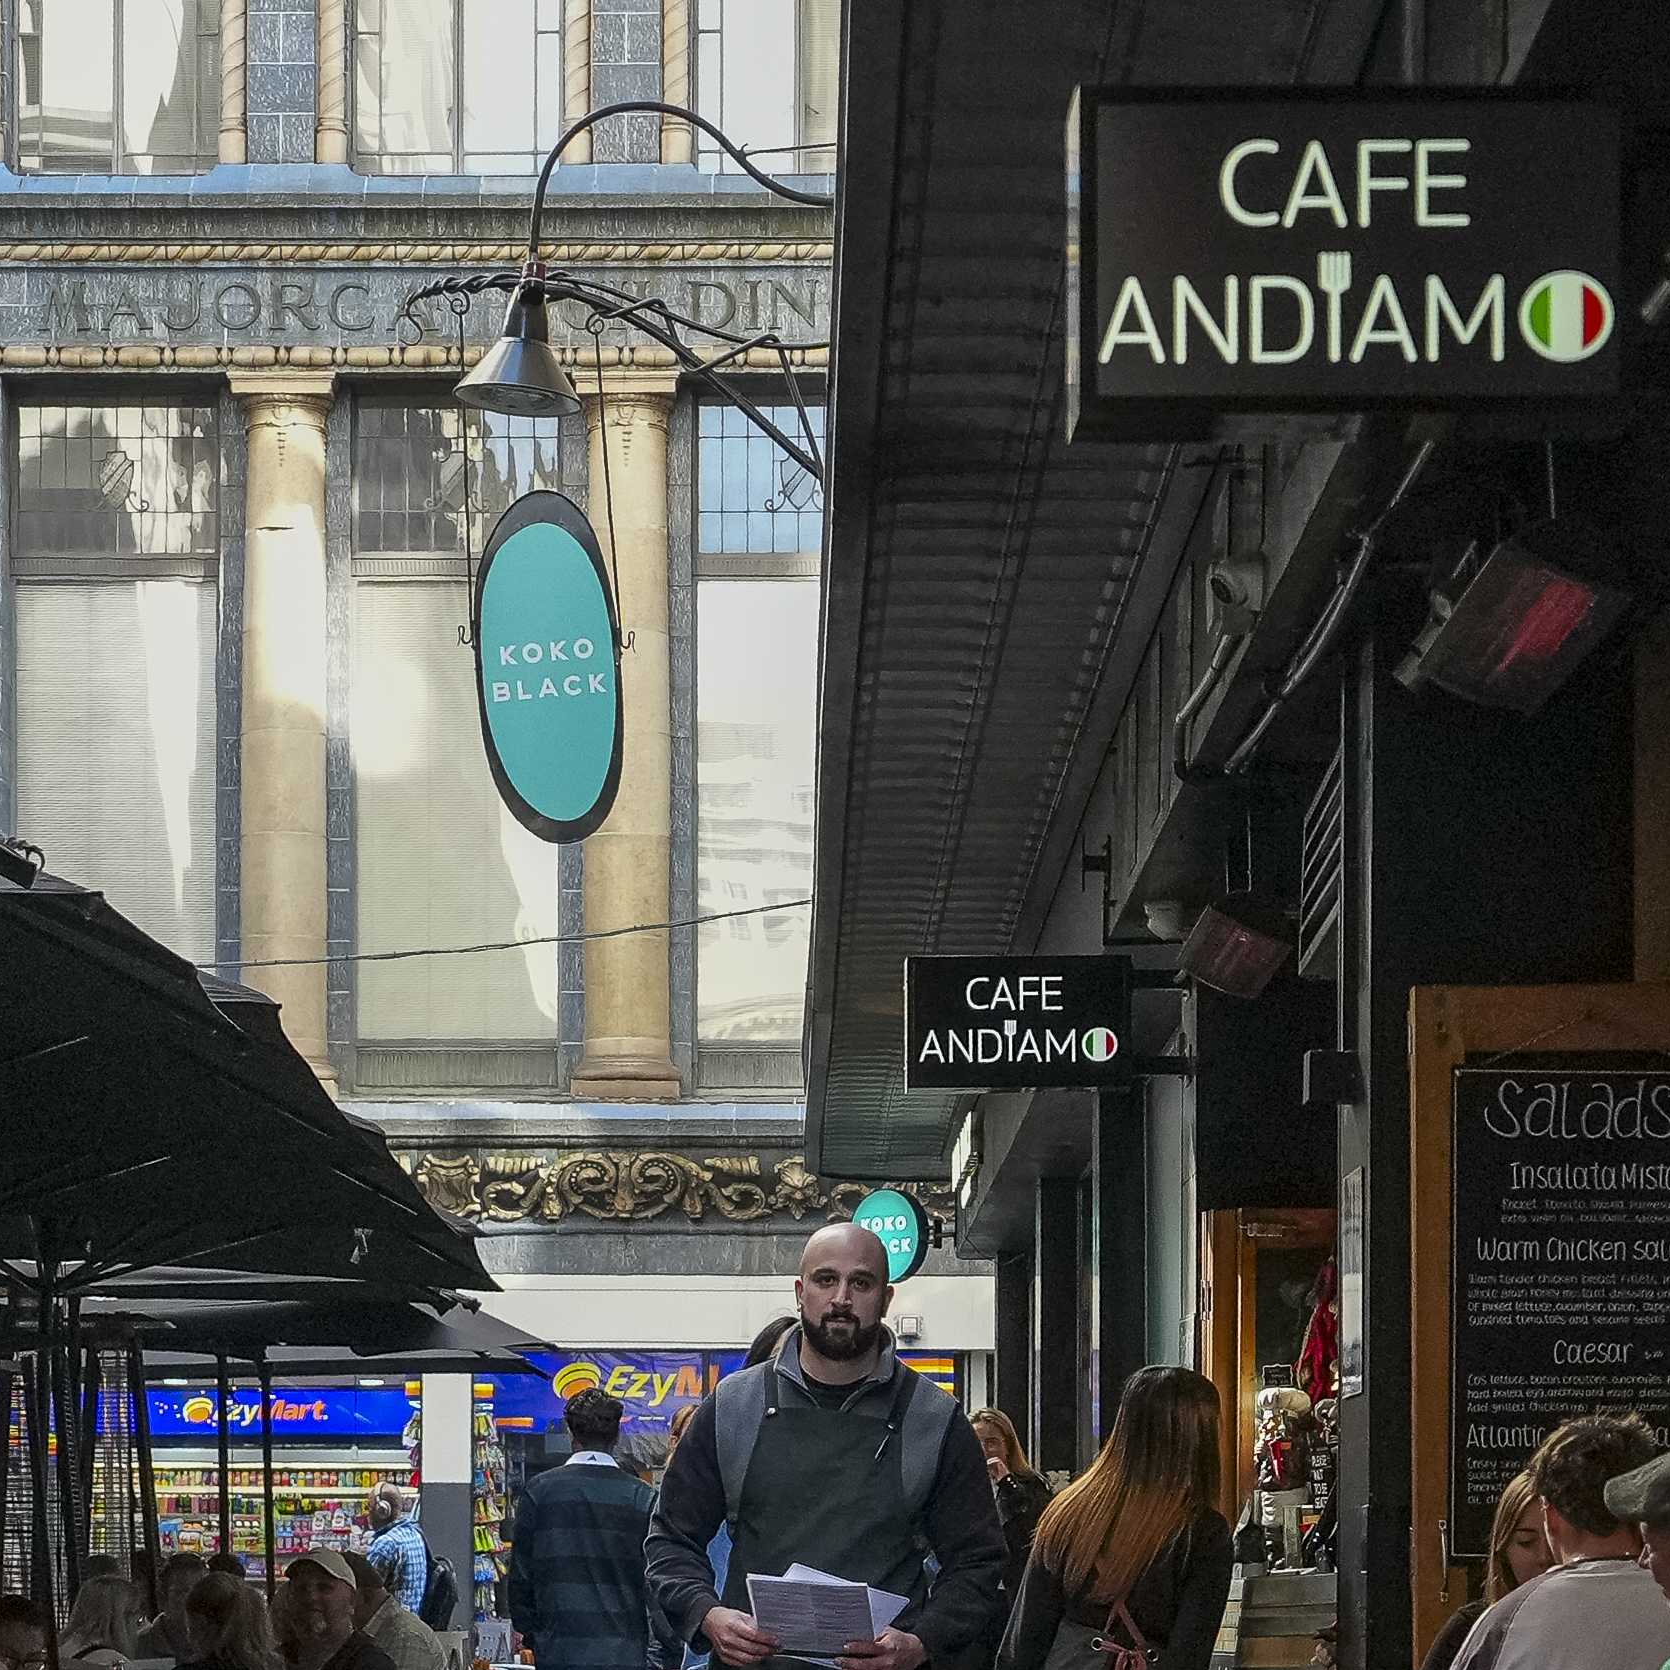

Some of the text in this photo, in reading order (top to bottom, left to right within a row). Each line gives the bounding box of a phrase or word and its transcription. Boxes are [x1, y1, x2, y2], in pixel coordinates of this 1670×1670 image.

[1219, 138, 1471, 228] CAFE
[37, 279, 440, 332] MAJORCA
[1098, 251, 1615, 364] ANDIAMO
[498, 637, 594, 666] KOKO
[491, 672, 607, 703] BLACK
[964, 975, 1064, 1012] CAFE
[918, 1018, 1119, 1064] ANDIAMO
[1510, 1161, 1618, 1190] Insalata
[860, 1215, 907, 1232] KOKO
[1476, 1237, 1540, 1262] Warm
[1546, 1236, 1628, 1262] Chicken
[1553, 1339, 1634, 1365] Caesar
[605, 1364, 721, 1408] EzyM
